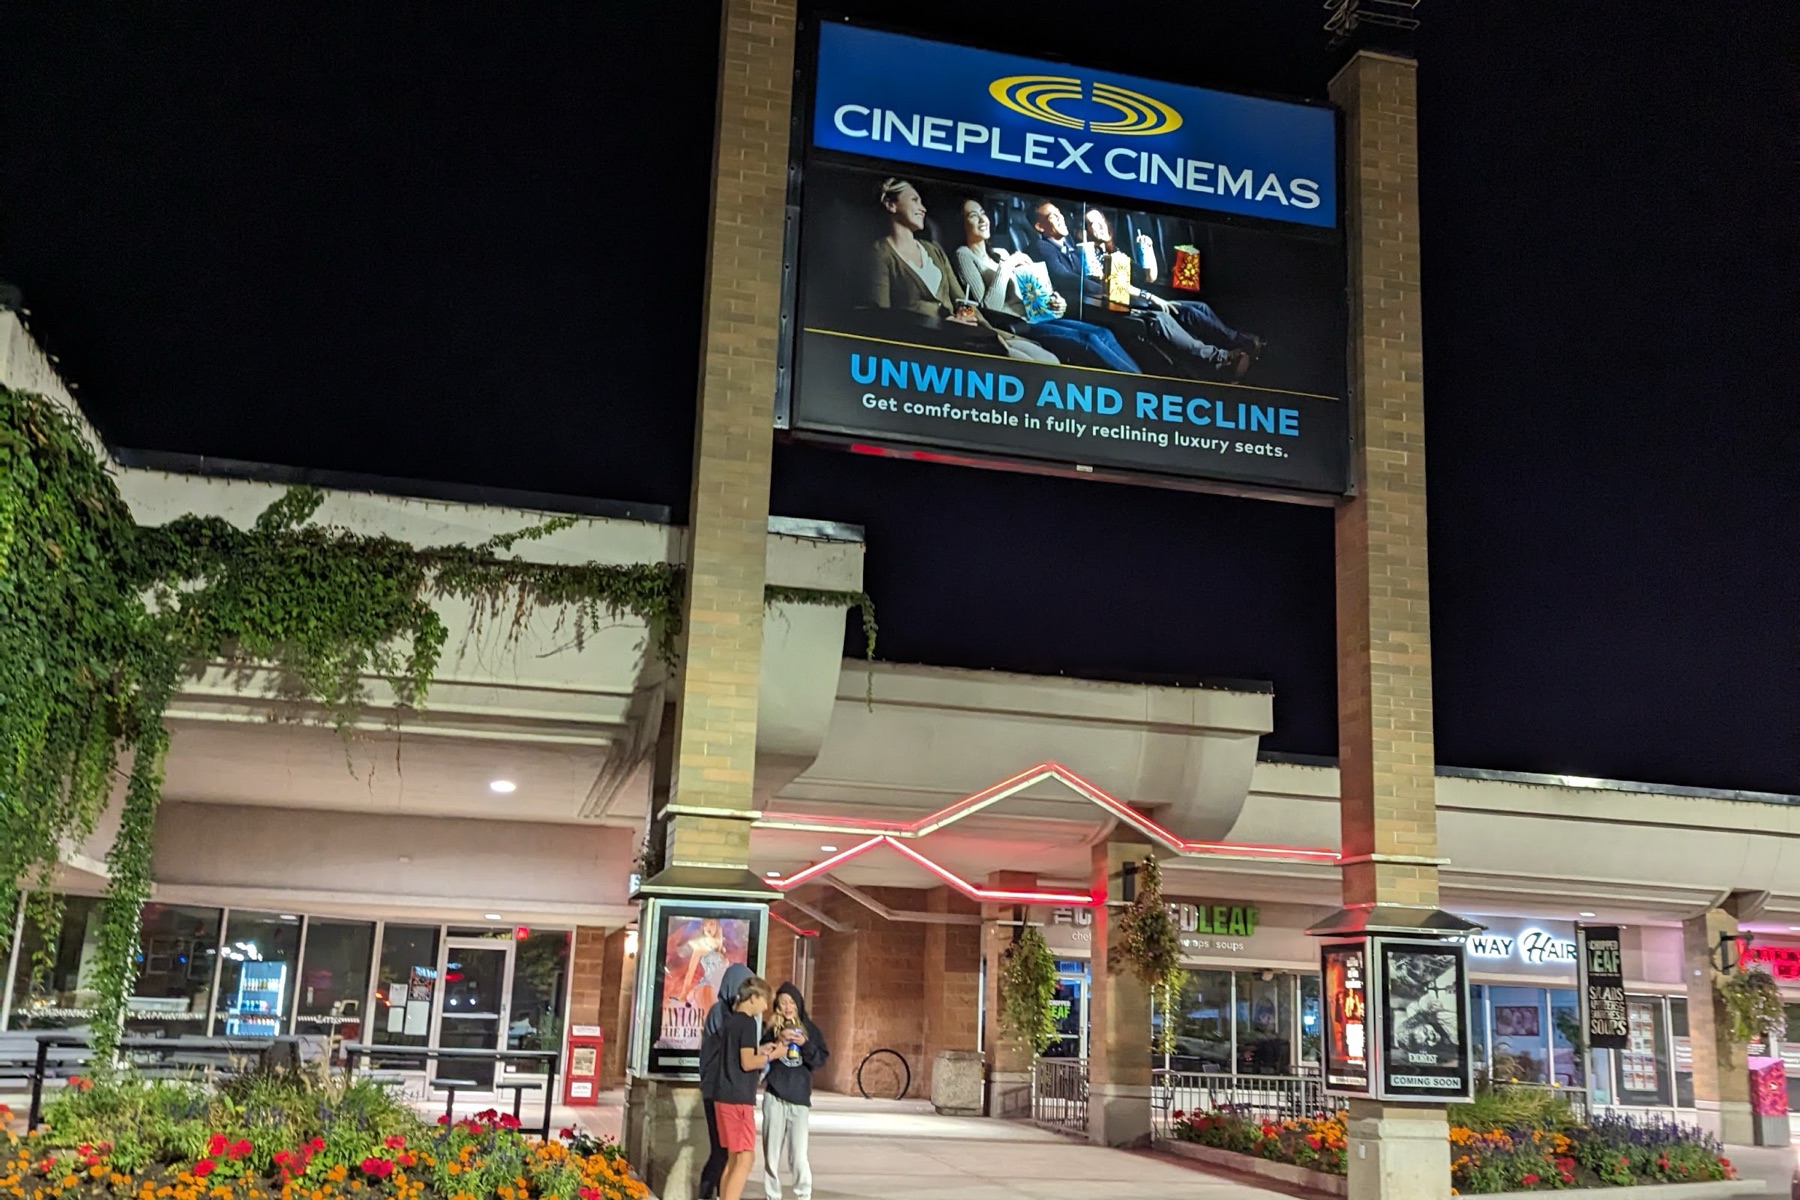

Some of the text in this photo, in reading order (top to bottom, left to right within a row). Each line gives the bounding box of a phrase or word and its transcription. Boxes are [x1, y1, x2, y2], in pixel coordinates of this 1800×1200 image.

[834, 104, 1321, 209] CINEPLEX CINEMAS
[851, 353, 1299, 437] UNWIND AND RECLINE
[862, 393, 1289, 458] Get comfortable in fully reclining luxury seats.
[1198, 904, 1258, 936] LEAF
[1216, 940, 1244, 952] soups
[1472, 938, 1513, 955] WAY
[1588, 950, 1620, 973] LEAF
[1051, 1005, 1070, 1019] EAF
[1393, 1076, 1459, 1087] COMING SOON
